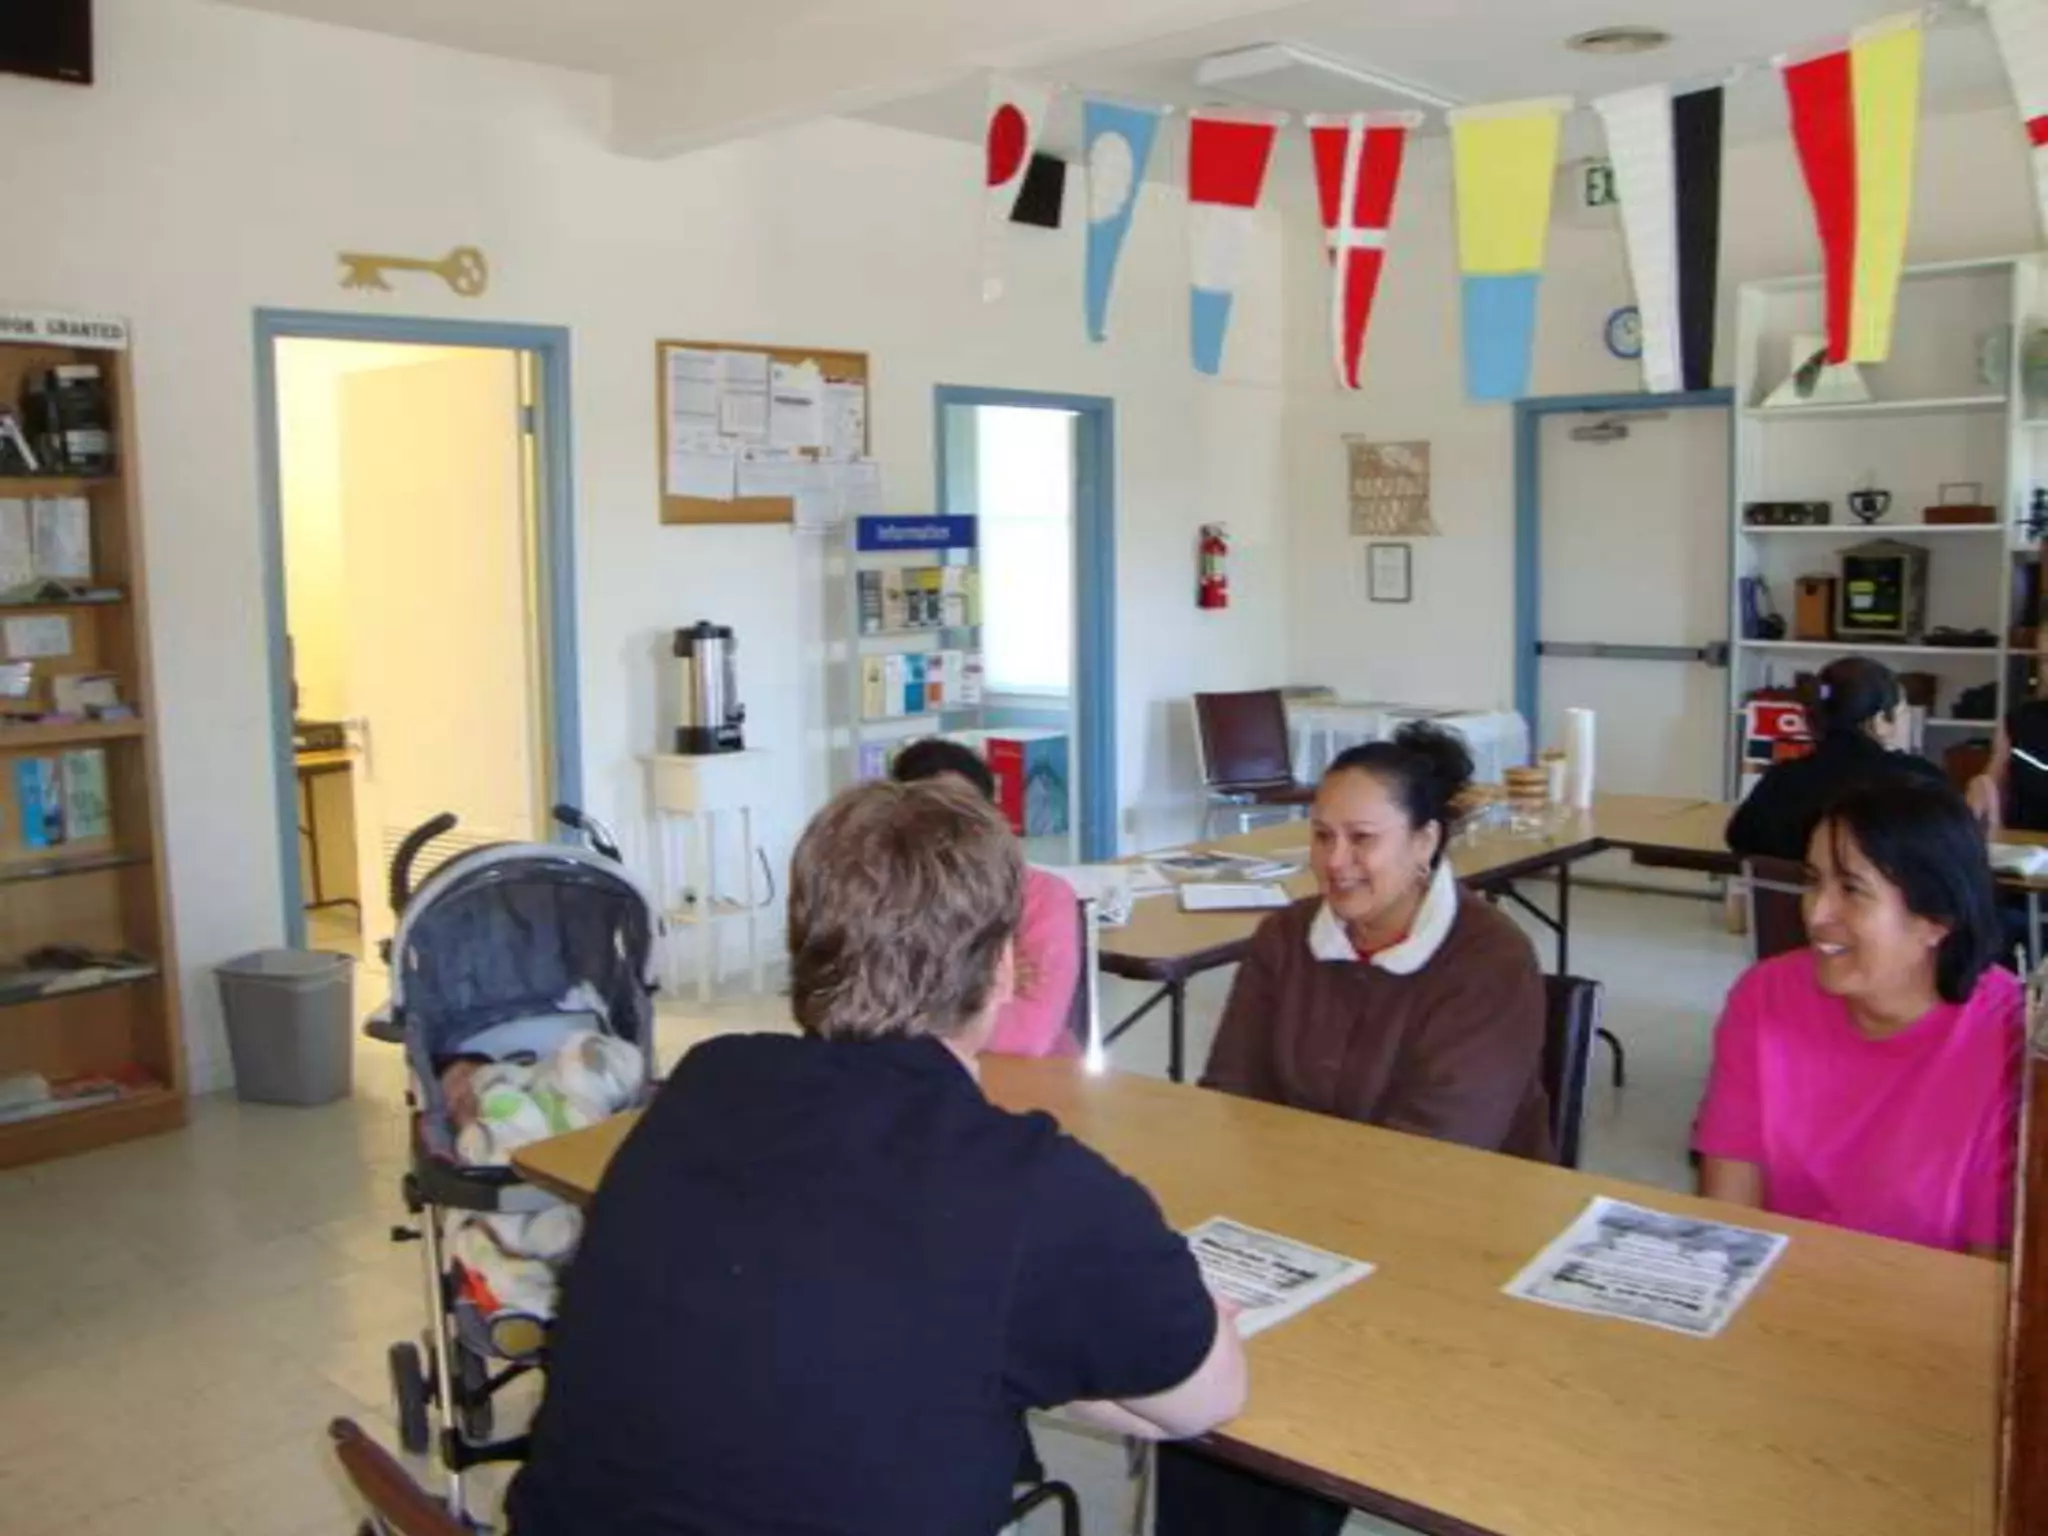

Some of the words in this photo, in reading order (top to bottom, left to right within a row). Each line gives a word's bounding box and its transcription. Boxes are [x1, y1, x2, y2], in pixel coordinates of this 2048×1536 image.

[1586, 167, 1619, 206] EX
[45, 318, 125, 340] GRANTED
[876, 522, 951, 541] Information
